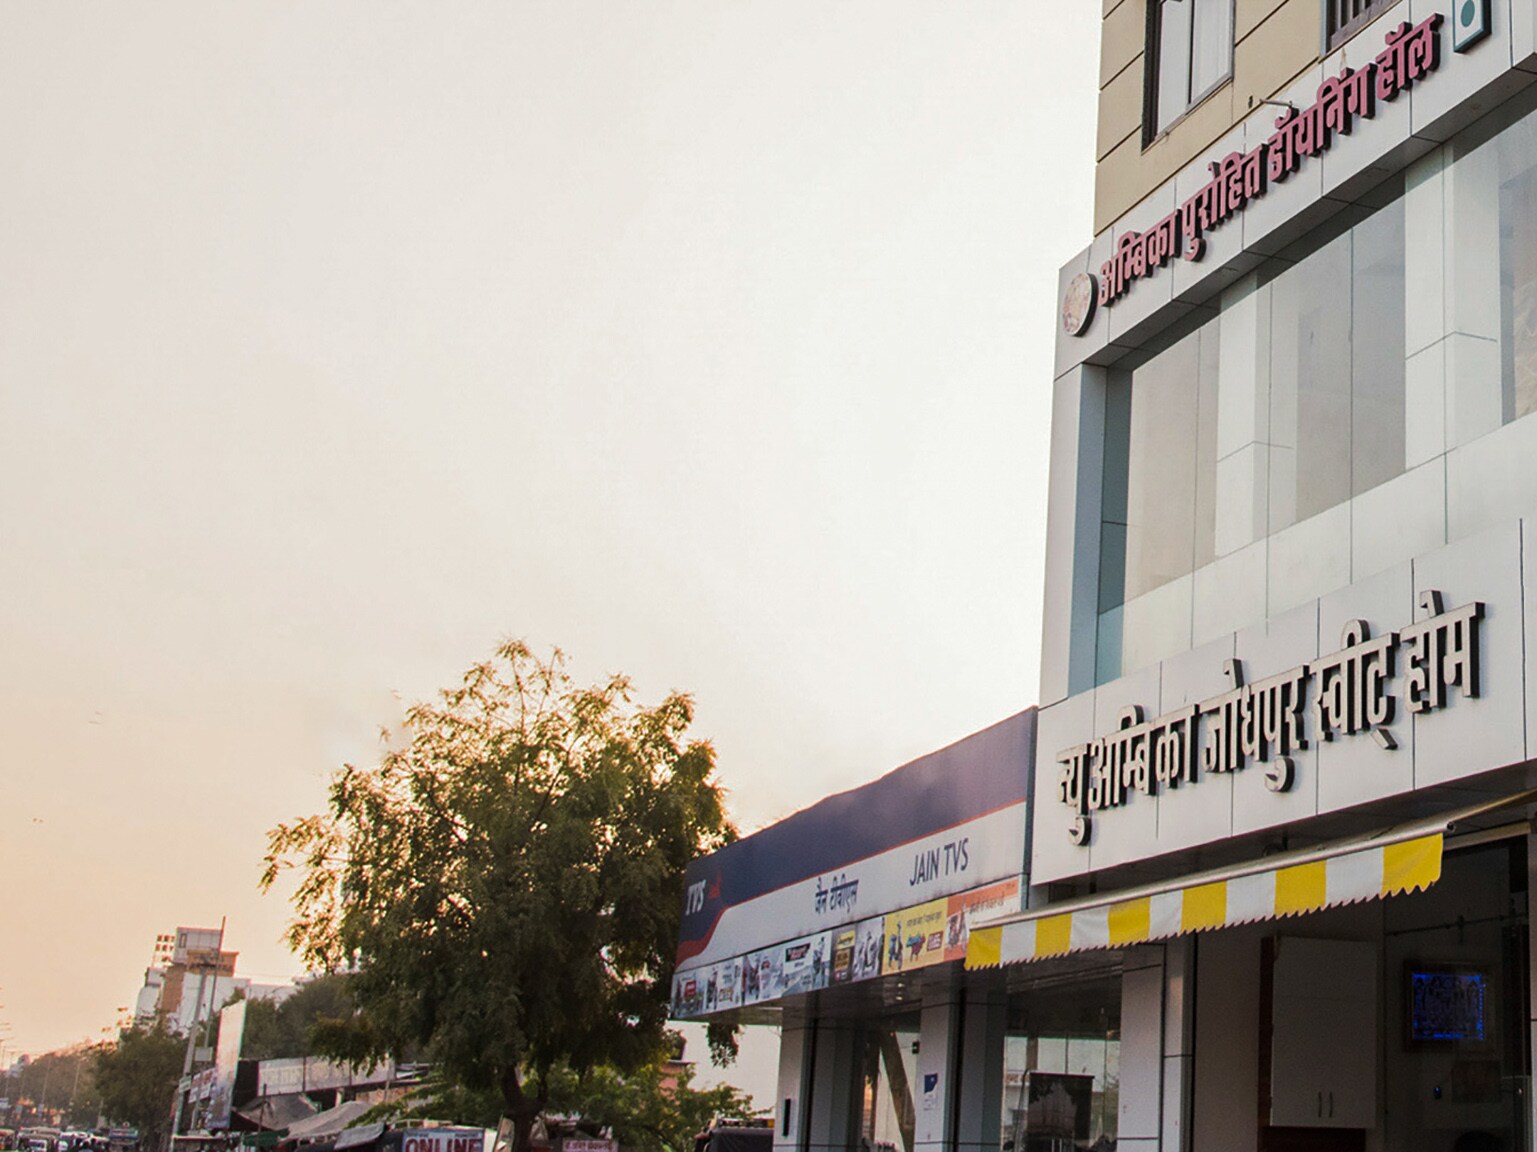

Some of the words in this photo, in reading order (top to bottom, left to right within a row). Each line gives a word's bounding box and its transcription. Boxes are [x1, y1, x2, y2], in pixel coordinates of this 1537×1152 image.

[1098, 209, 1182, 307] अम्बिका
[1181, 144, 1269, 262] पुरोहित
[1375, 13, 1444, 101] हॉल
[1088, 704, 1200, 809] अम्बिका
[1200, 659, 1310, 792] जोधपुर
[1399, 589, 1485, 713] होम
[685, 879, 706, 916] TVS
[909, 847, 940, 886] JAIN
[944, 837, 969, 876] TVS
